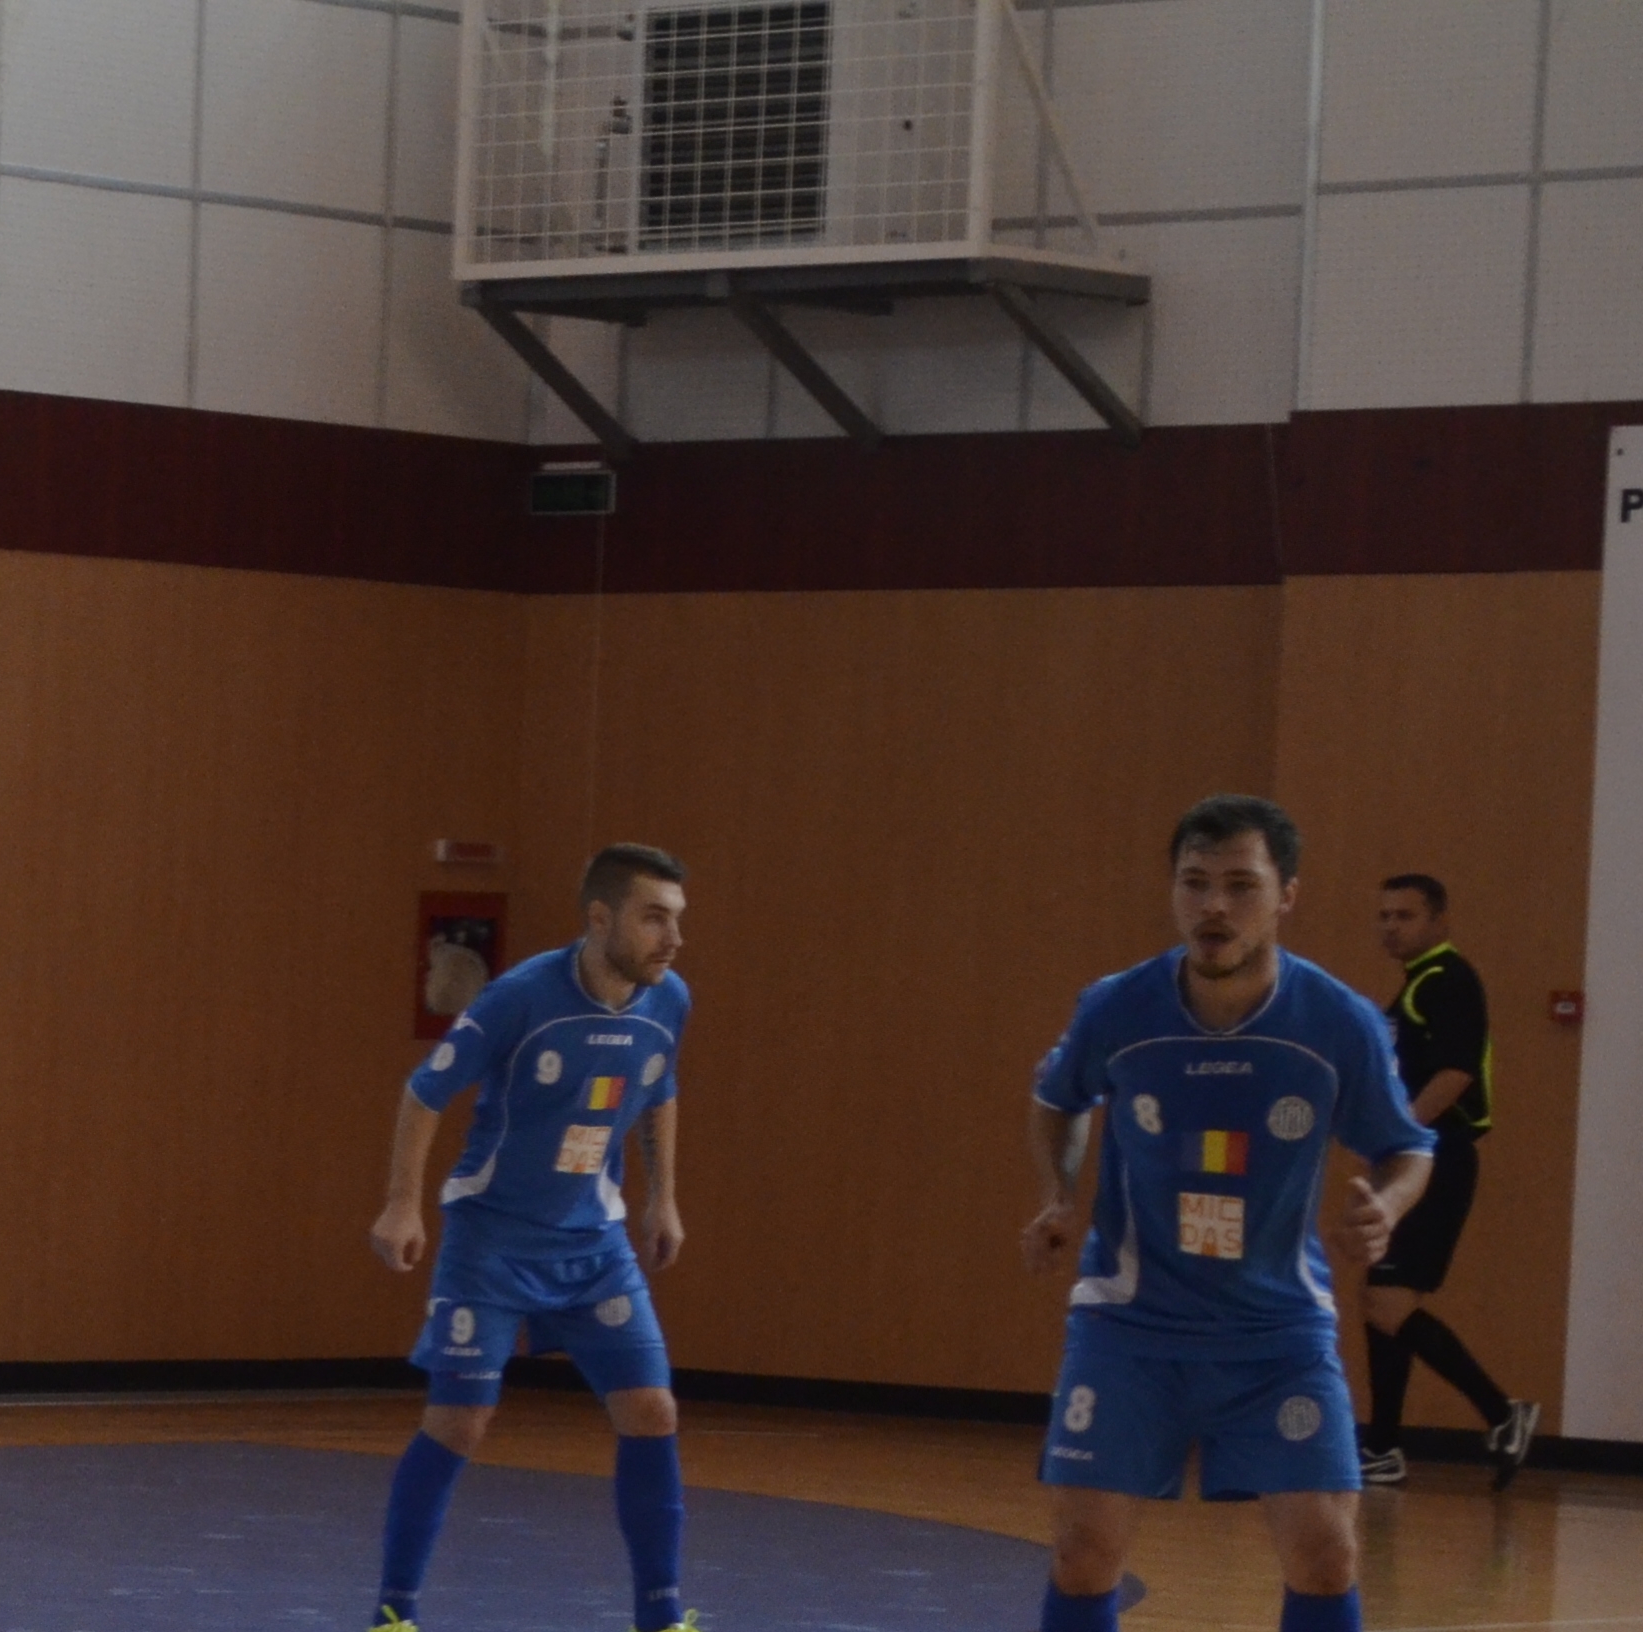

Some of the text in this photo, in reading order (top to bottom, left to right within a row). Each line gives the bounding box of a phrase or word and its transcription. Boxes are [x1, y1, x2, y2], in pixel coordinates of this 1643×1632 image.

[535, 1050, 562, 1086] 9
[1132, 1093, 1164, 1136] 8
[450, 1307, 476, 1345] 9
[1064, 1385, 1097, 1433] 8
